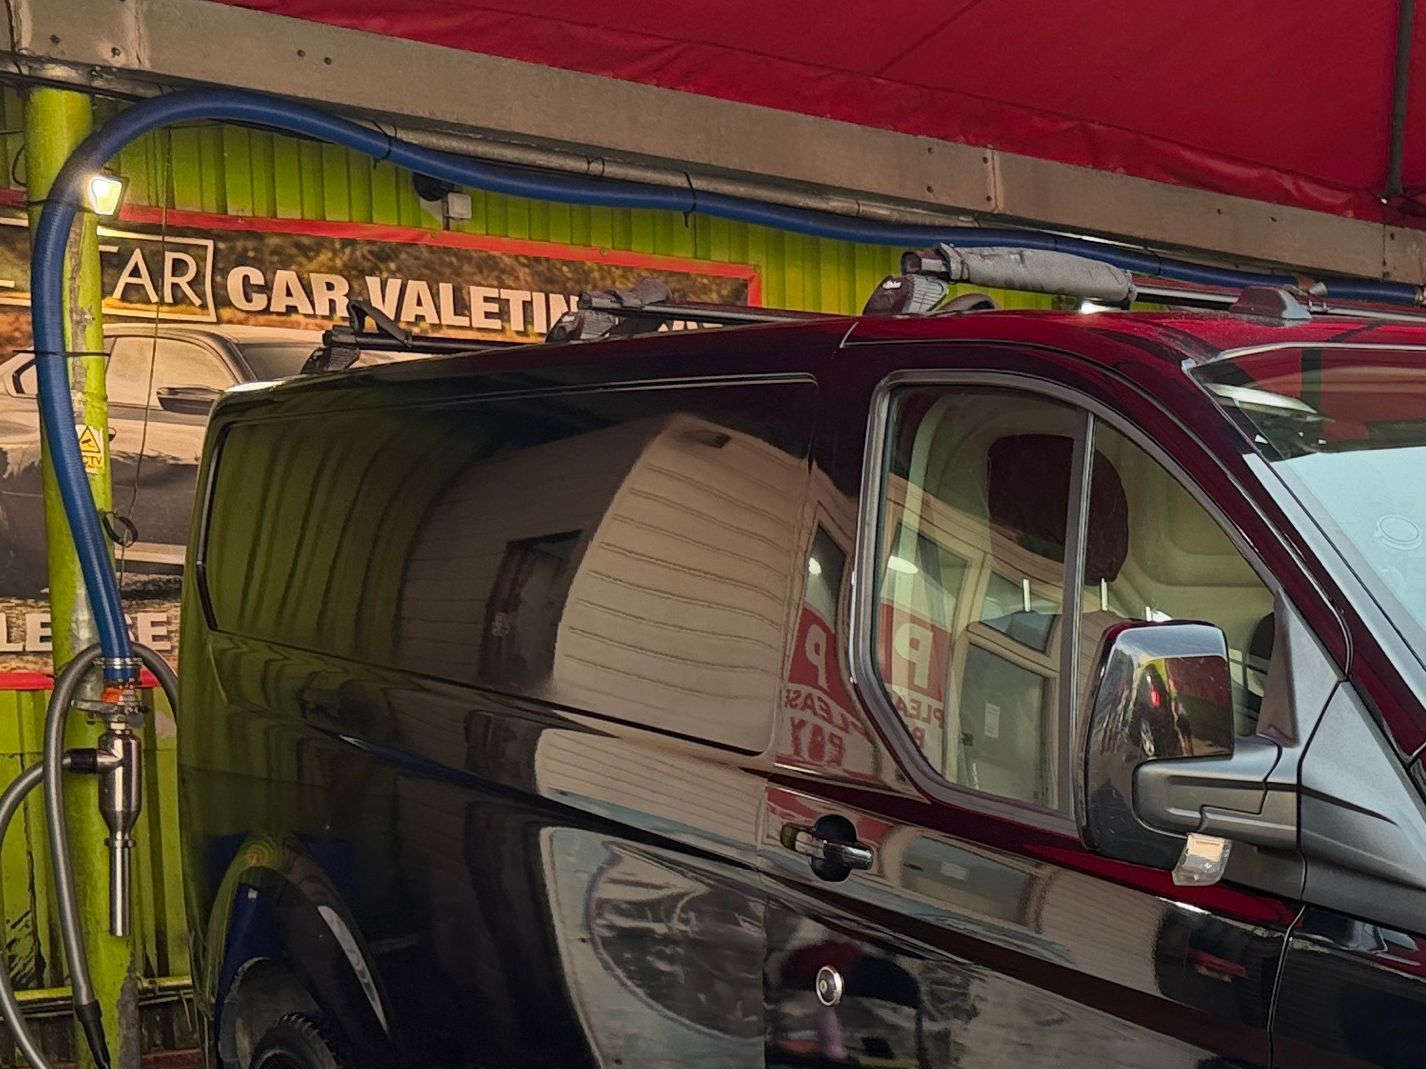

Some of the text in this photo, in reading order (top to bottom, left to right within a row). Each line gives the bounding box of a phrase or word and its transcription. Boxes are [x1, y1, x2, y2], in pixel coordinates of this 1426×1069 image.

[99, 245, 579, 334] AR CAR VALETIN
